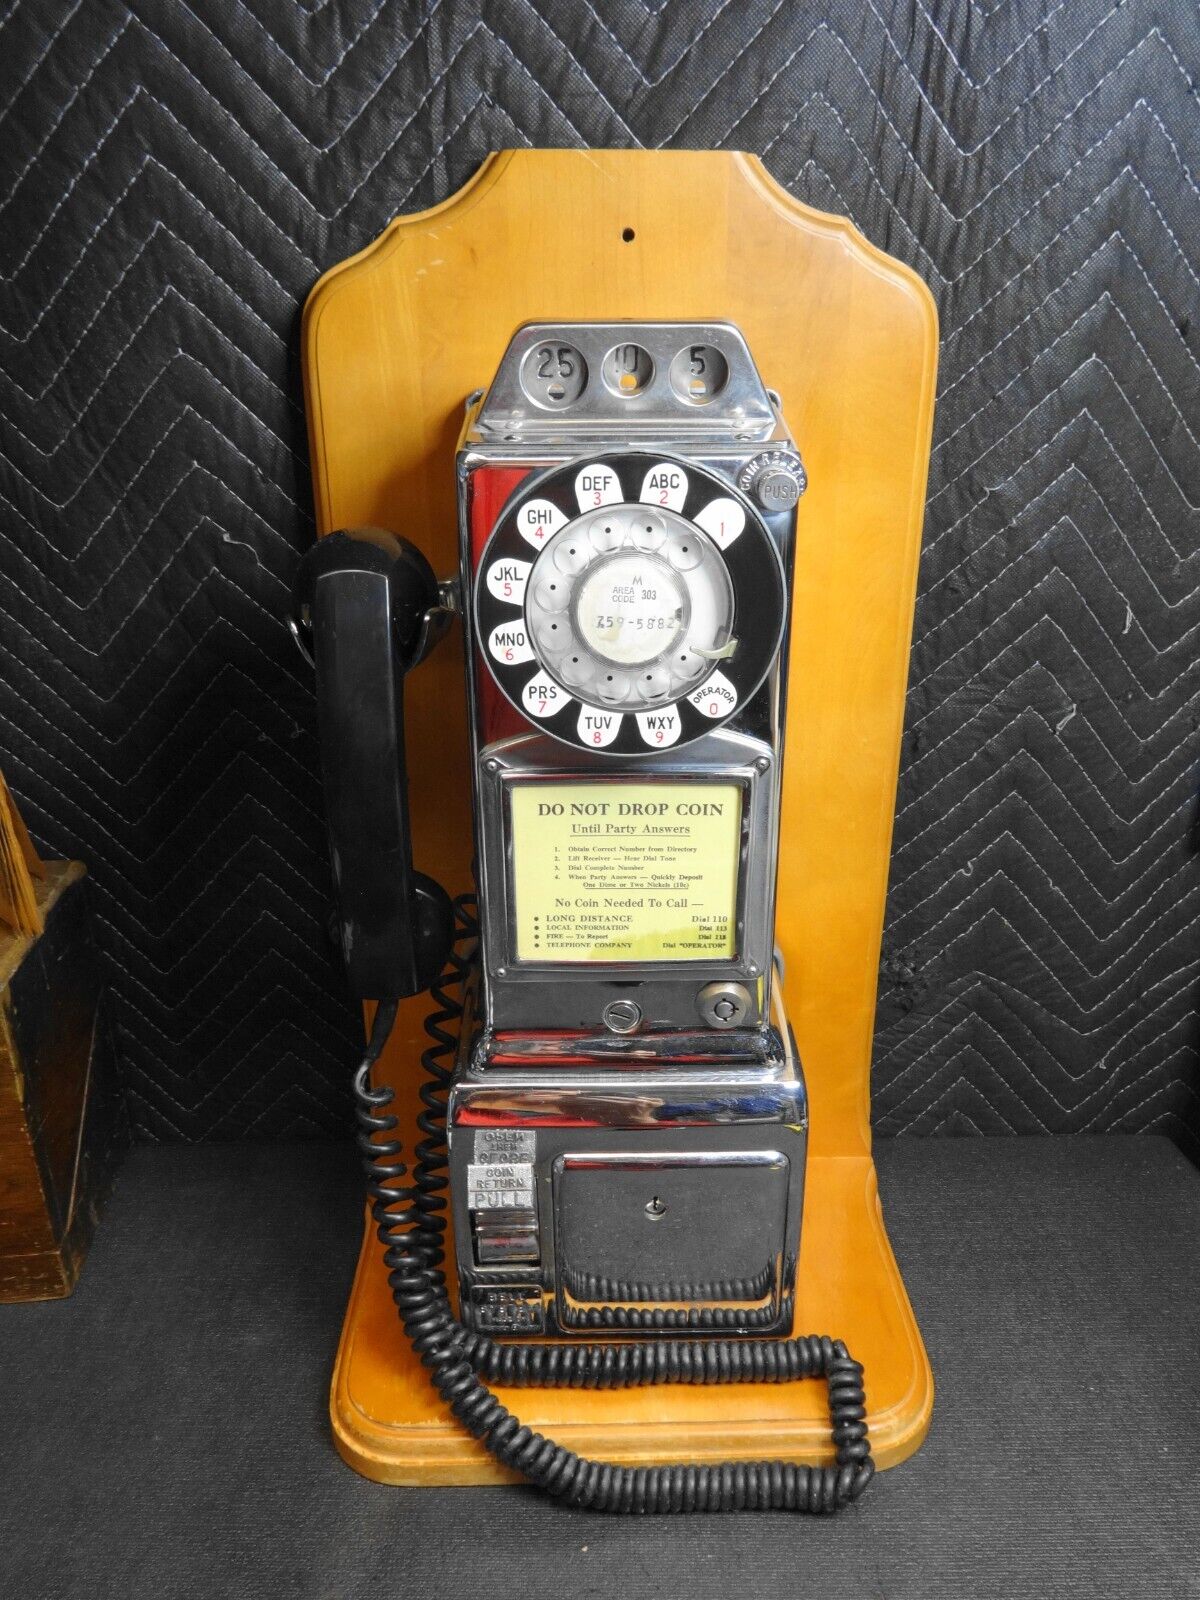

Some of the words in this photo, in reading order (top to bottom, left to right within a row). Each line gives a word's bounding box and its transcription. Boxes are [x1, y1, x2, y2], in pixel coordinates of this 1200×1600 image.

[537, 347, 574, 378] 25
[690, 346, 706, 375] 5
[582, 476, 612, 491] DEF
[649, 474, 680, 489] ABC
[593, 492, 602, 506] 3
[659, 490, 669, 504] 2
[765, 486, 797, 499] PUSH
[527, 509, 552, 524] GHI
[534, 526, 545, 539] 4
[494, 566, 524, 581] JKL
[503, 583, 513, 597] 5
[641, 590, 657, 600] 303
[612, 595, 635, 603] CODE
[495, 632, 525, 646] MNO
[505, 648, 514, 660] 6
[528, 686, 557, 698] PRS
[693, 686, 735, 704] OPERATOR
[538, 701, 546, 712] 7
[709, 703, 718, 715] 0
[585, 716, 612, 729] TUV
[647, 716, 674, 729] WXY
[593, 732, 602, 744] 8
[656, 731, 664, 743] 9
[538, 803, 564, 816] DO
[571, 803, 610, 816] NOT
[618, 803, 669, 816] DROP
[676, 803, 724, 816] COIN
[571, 824, 601, 834] Until
[605, 824, 637, 835] Party
[642, 824, 691, 834] Answers
[555, 899, 571, 908] No
[575, 899, 599, 908] Coin
[604, 899, 643, 908] Needed
[649, 899, 662, 908] To
[666, 898, 688, 908] Call
[486, 1167, 515, 1177] COIN
[476, 1179, 526, 1188] RETURN
[475, 1192, 525, 1208] PULL
